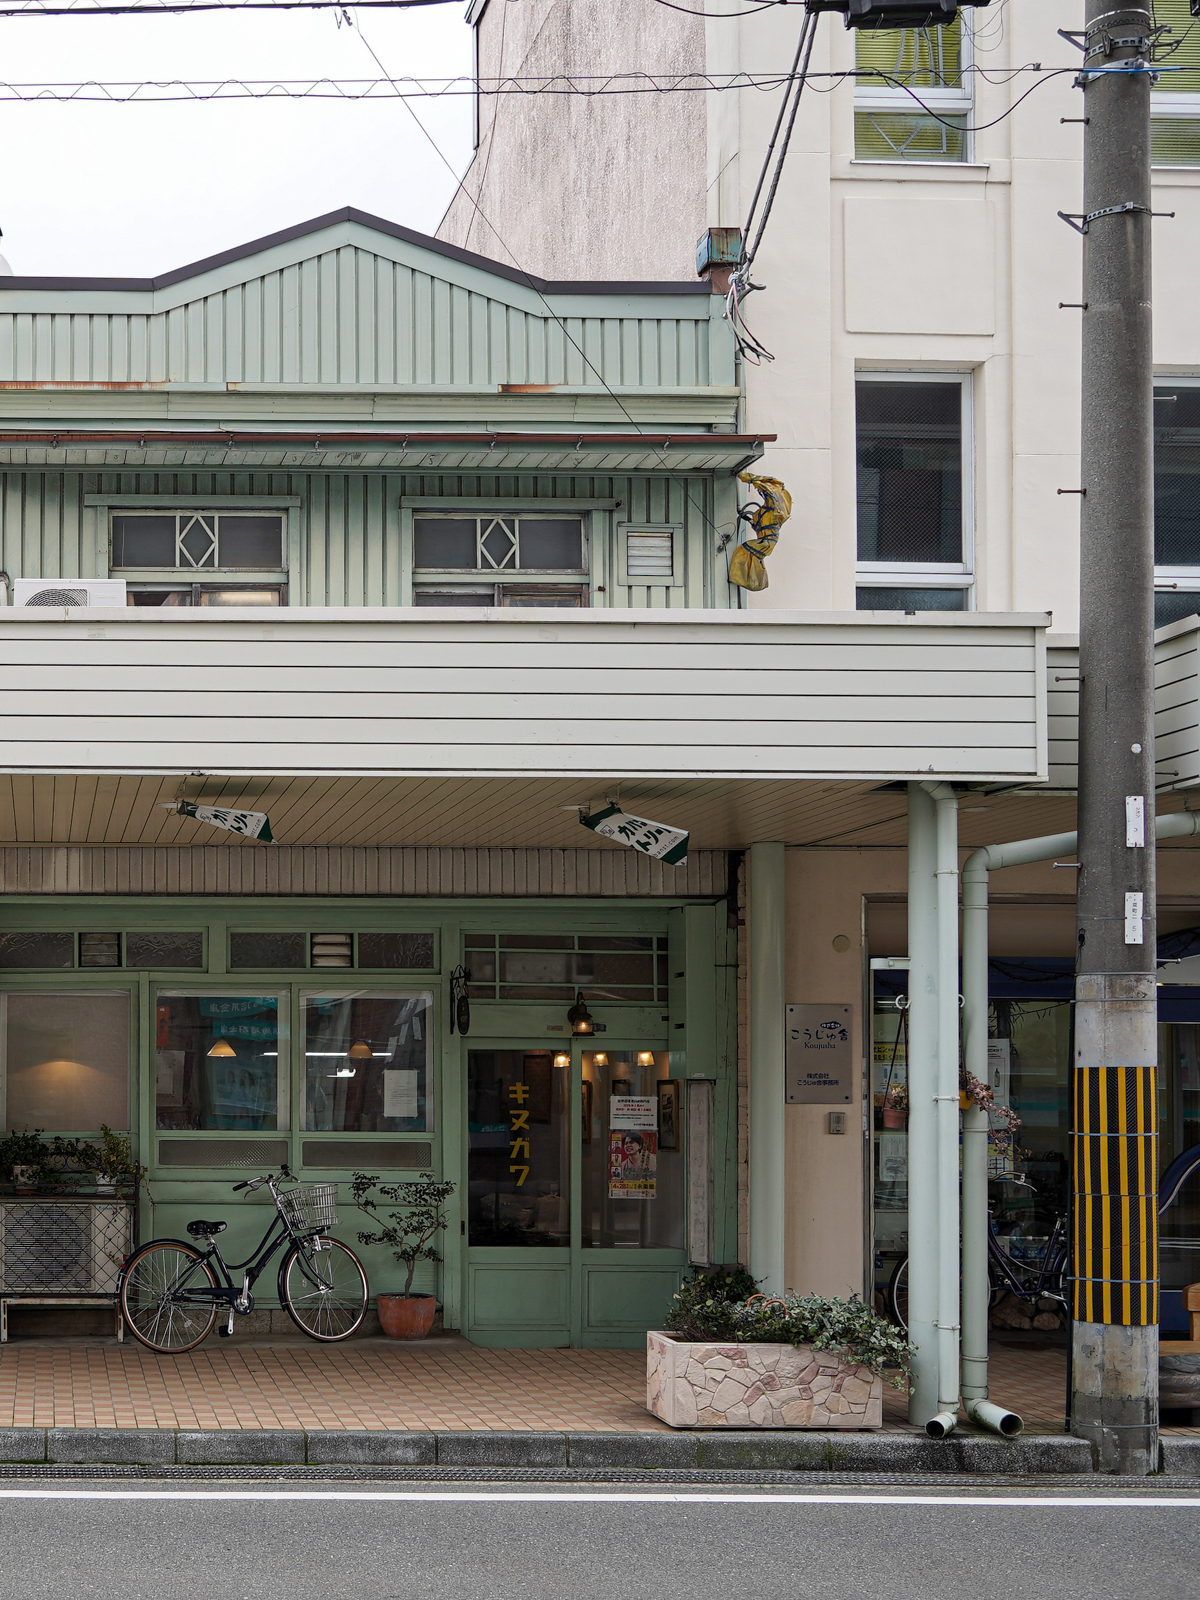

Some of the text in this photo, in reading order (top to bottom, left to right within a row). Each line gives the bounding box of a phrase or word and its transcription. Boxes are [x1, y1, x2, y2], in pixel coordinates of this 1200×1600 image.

[791, 1028, 849, 1041] こうじゅ舎
[804, 1042, 836, 1050] Koujusha
[508, 1081, 530, 1187] キヌガワ
